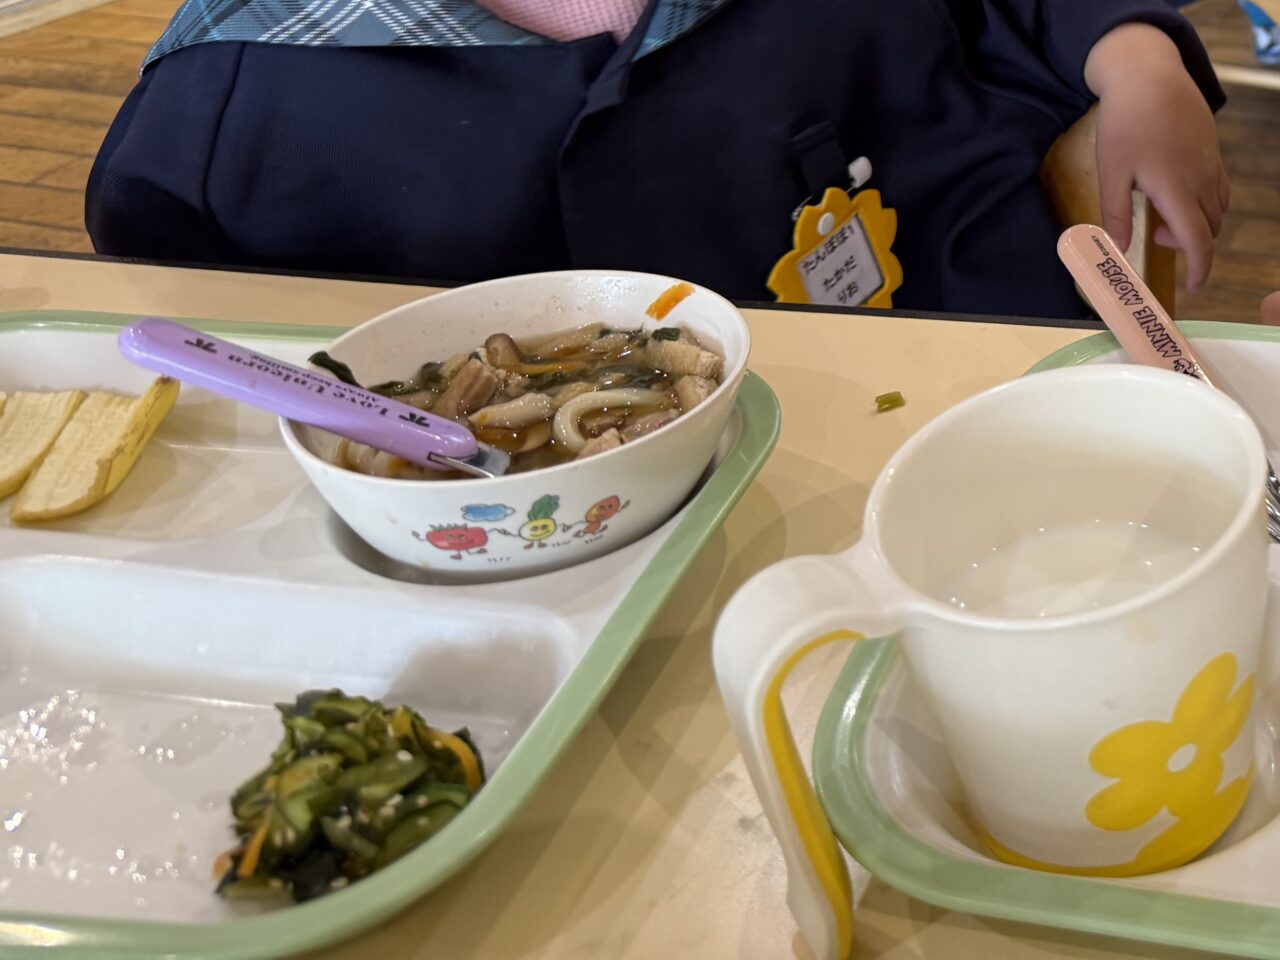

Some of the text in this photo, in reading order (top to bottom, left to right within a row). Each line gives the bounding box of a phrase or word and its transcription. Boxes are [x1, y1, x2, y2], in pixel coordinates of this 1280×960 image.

[1096, 256, 1182, 358] MINNIE MOUSE
[227, 353, 389, 416] Love Unicorn
